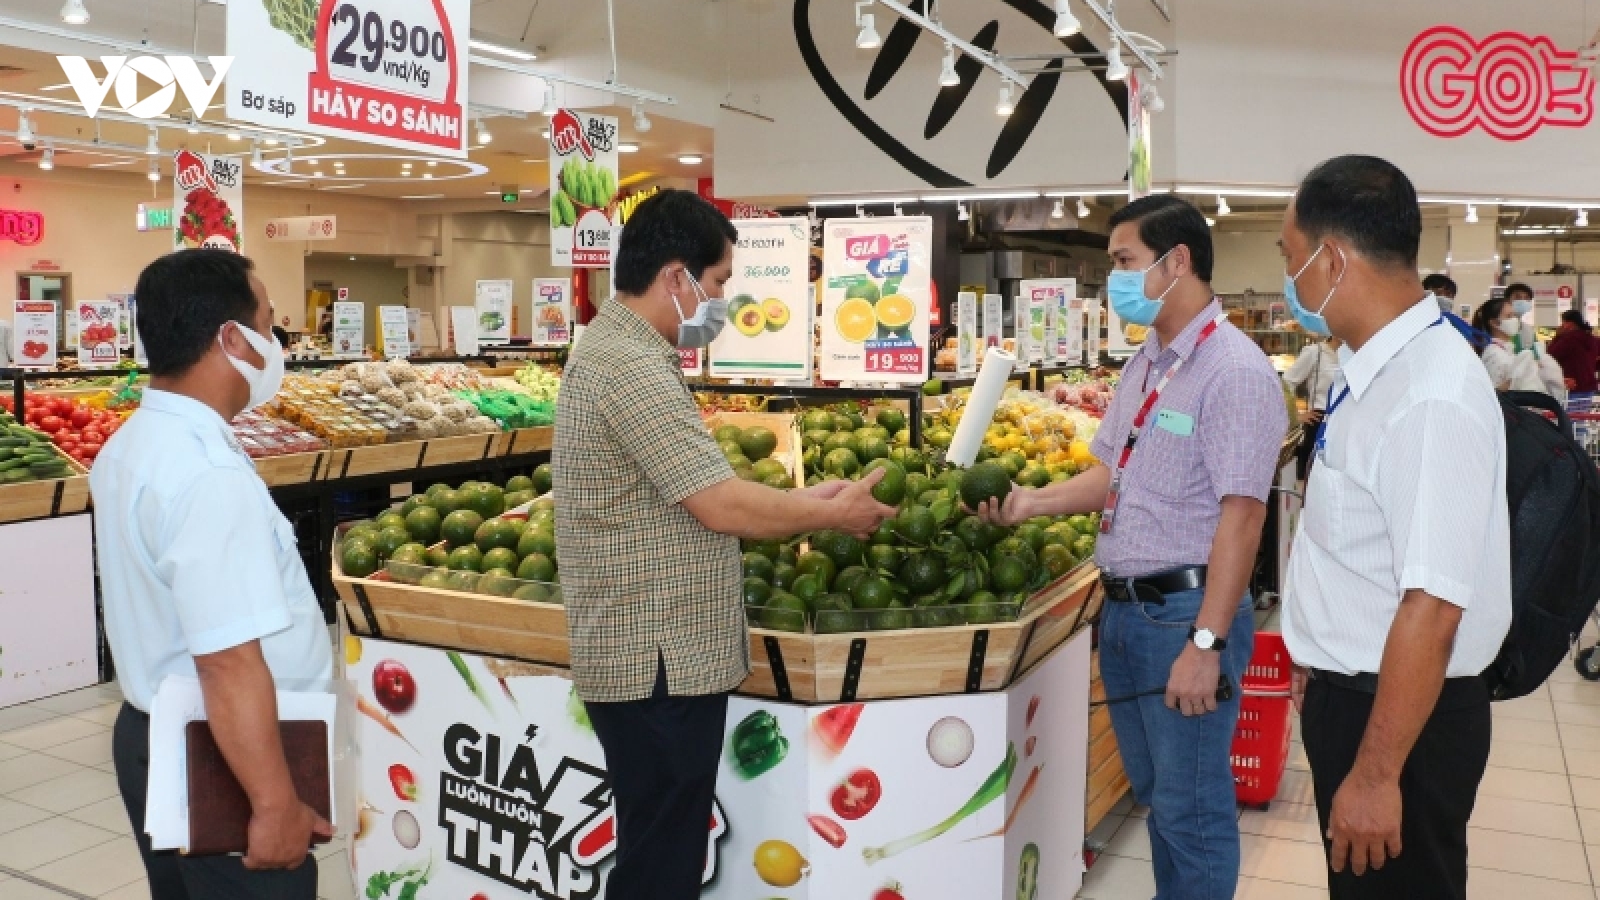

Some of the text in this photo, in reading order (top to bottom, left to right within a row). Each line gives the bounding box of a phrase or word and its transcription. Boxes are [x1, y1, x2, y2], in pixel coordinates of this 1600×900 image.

[383, 60, 431, 88] vnd/Kg
[241, 89, 296, 118] Bơ sáp
[366, 99, 398, 128] SO
[401, 104, 459, 139] SÁNH
[442, 722, 544, 794] GIÁ
[445, 778, 541, 828] LUÔN LUÔN
